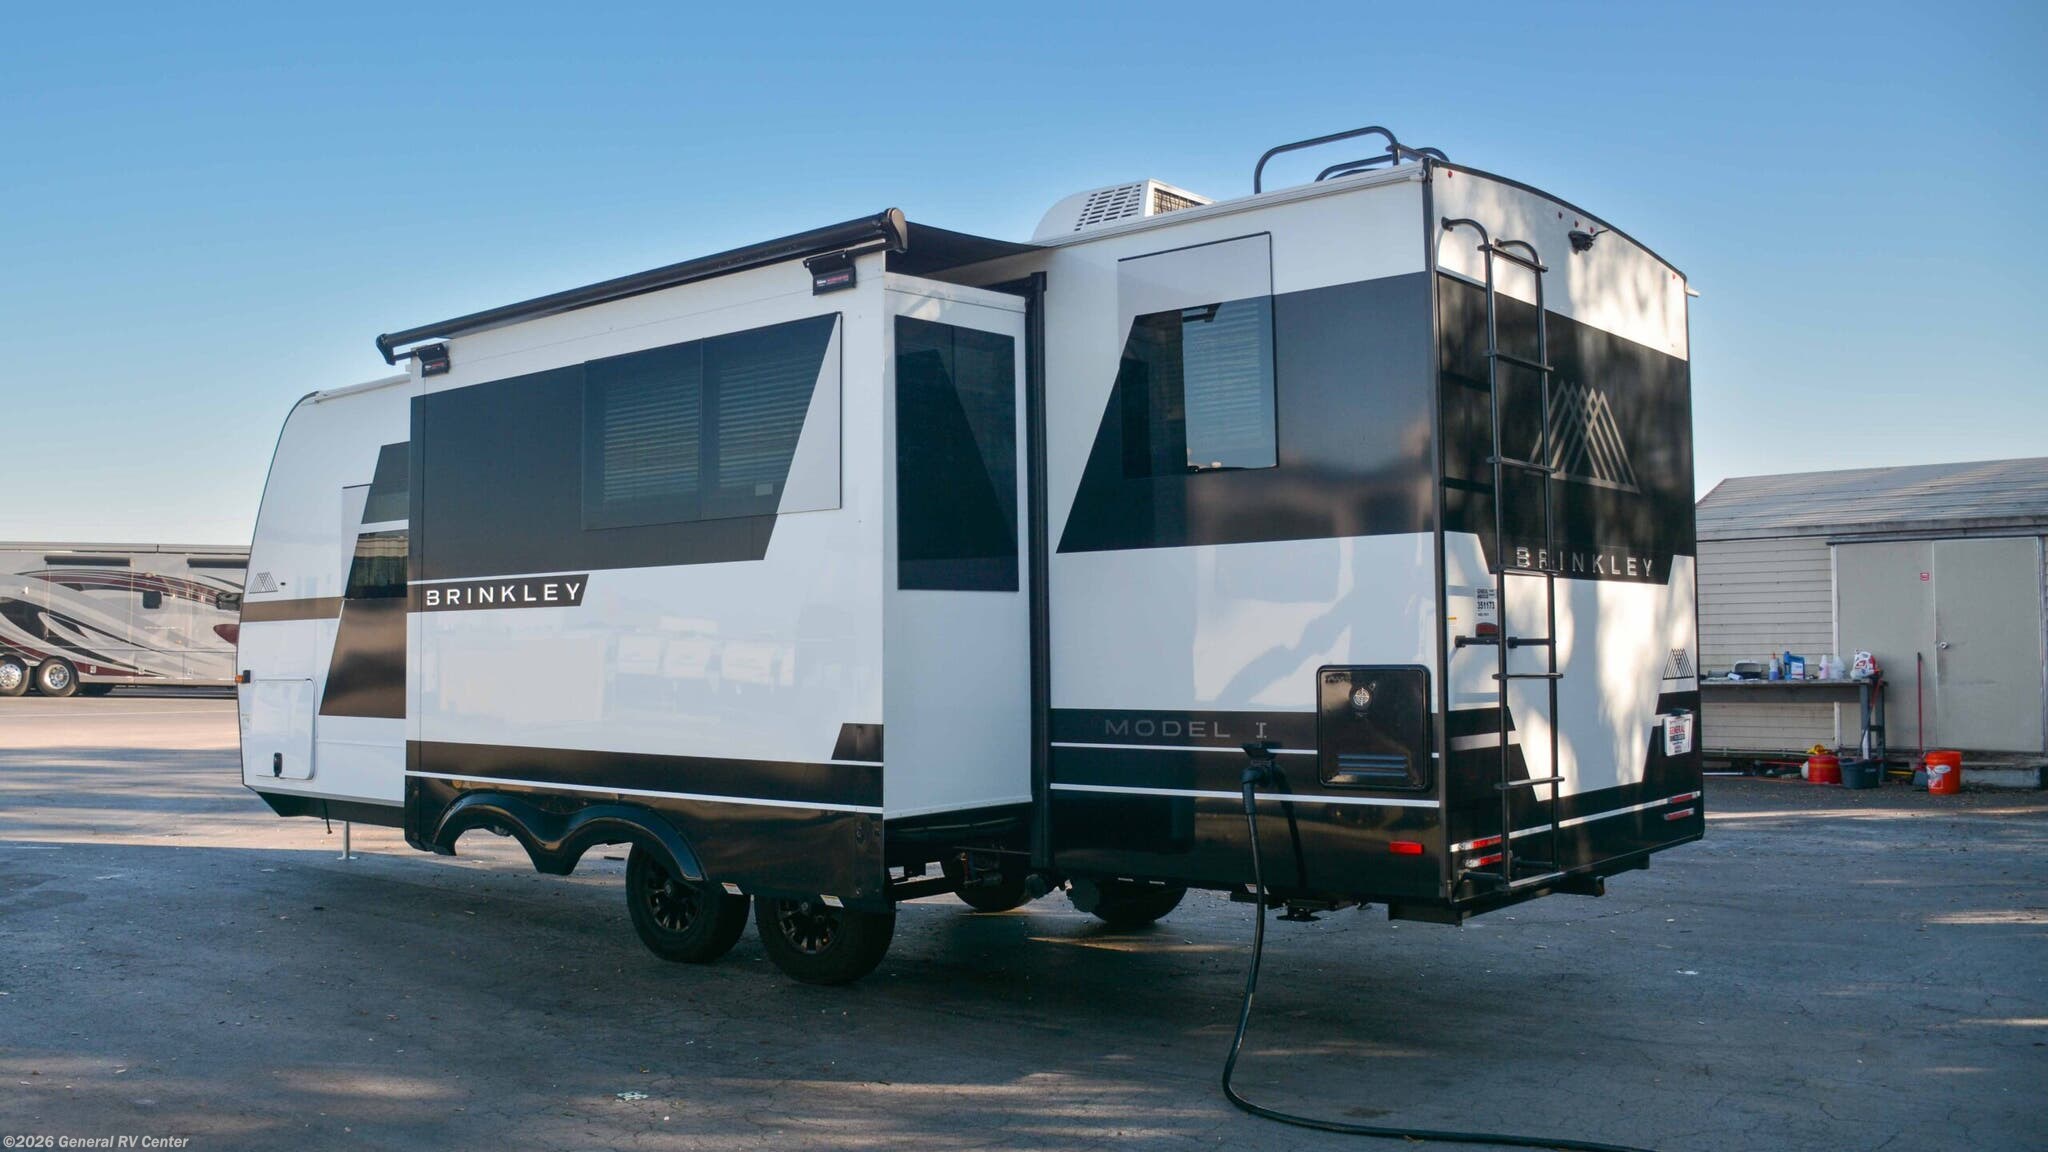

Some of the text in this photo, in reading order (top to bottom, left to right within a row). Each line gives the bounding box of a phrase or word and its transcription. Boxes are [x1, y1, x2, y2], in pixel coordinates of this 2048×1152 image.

[1516, 546, 1653, 577] BRINKLEY
[426, 582, 580, 606] BRINKLEY
[1105, 719, 1268, 739] MODEL I
